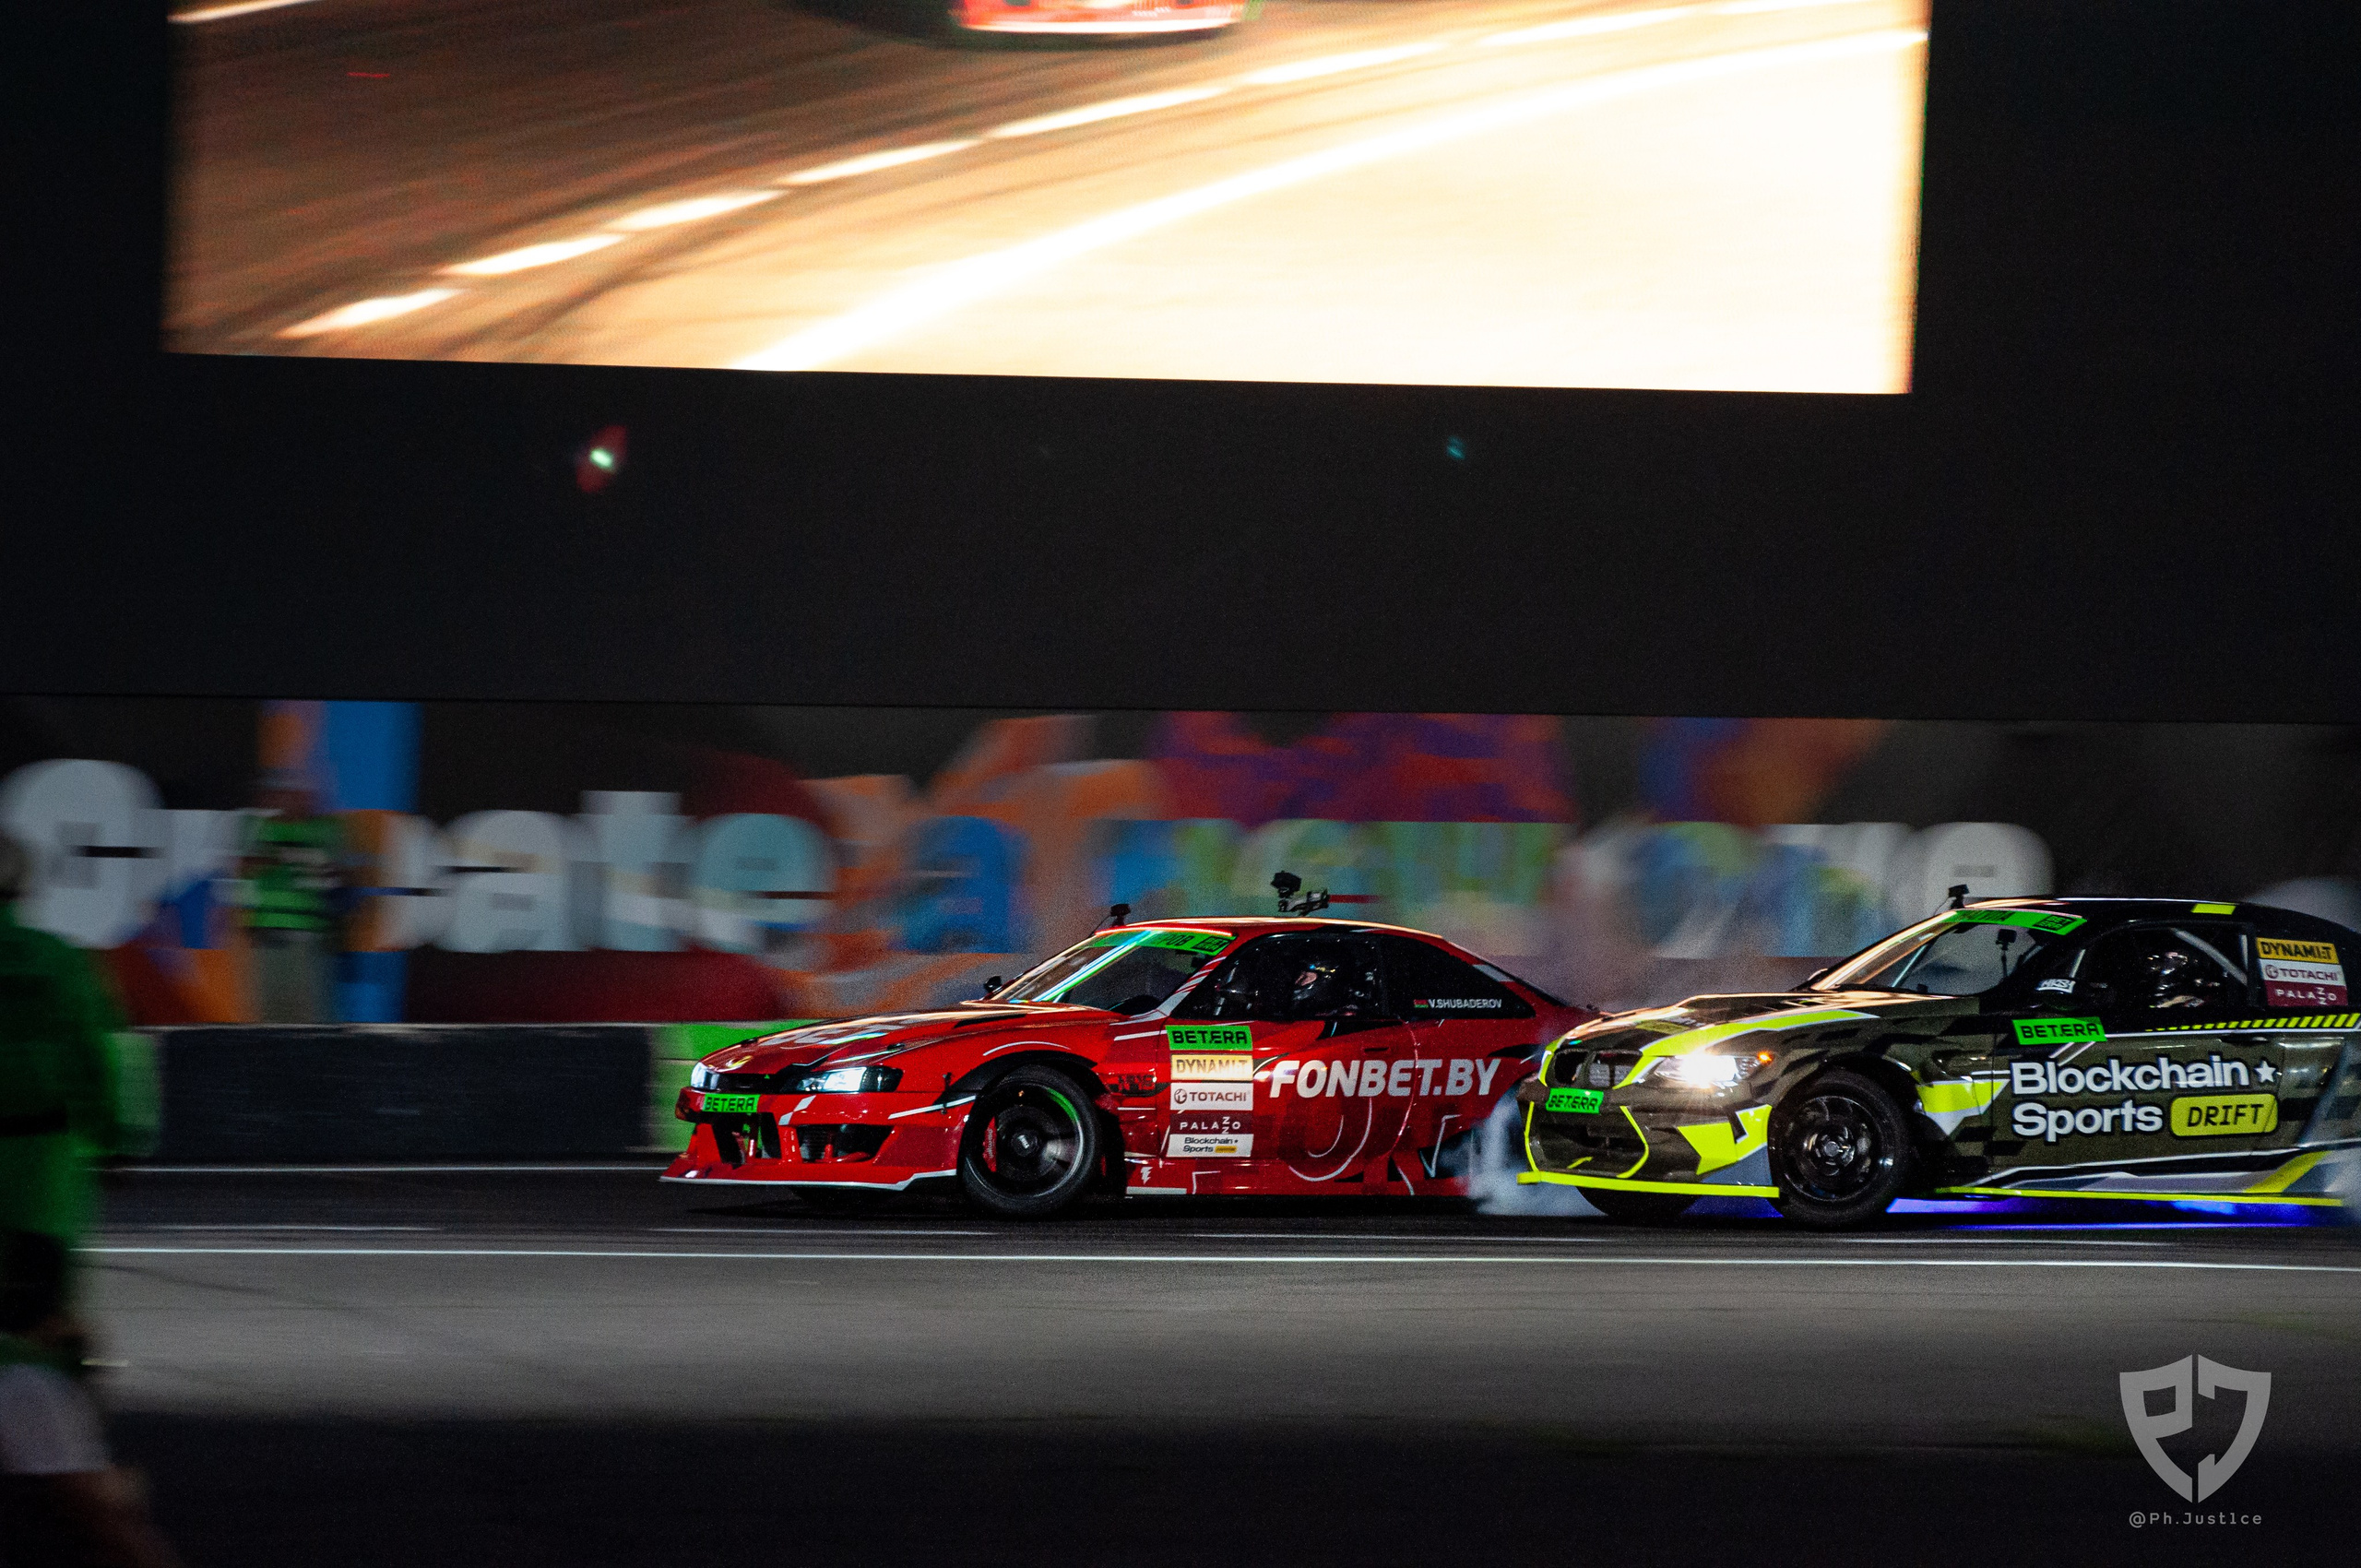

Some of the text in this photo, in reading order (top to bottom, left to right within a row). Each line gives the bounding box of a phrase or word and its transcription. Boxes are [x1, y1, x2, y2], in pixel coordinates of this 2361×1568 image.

[2280, 968, 2338, 980] TOTACHI
[2275, 987, 2337, 1005] PALAZZO
[1269, 1058, 1501, 1098] FONBET.BY
[2011, 1055, 2249, 1095] Blockchain
[1189, 1092, 1247, 1101] TOTACHI
[1180, 1116, 1241, 1134] PALAZZO
[2012, 1099, 2264, 1143] Sports DRIFT
